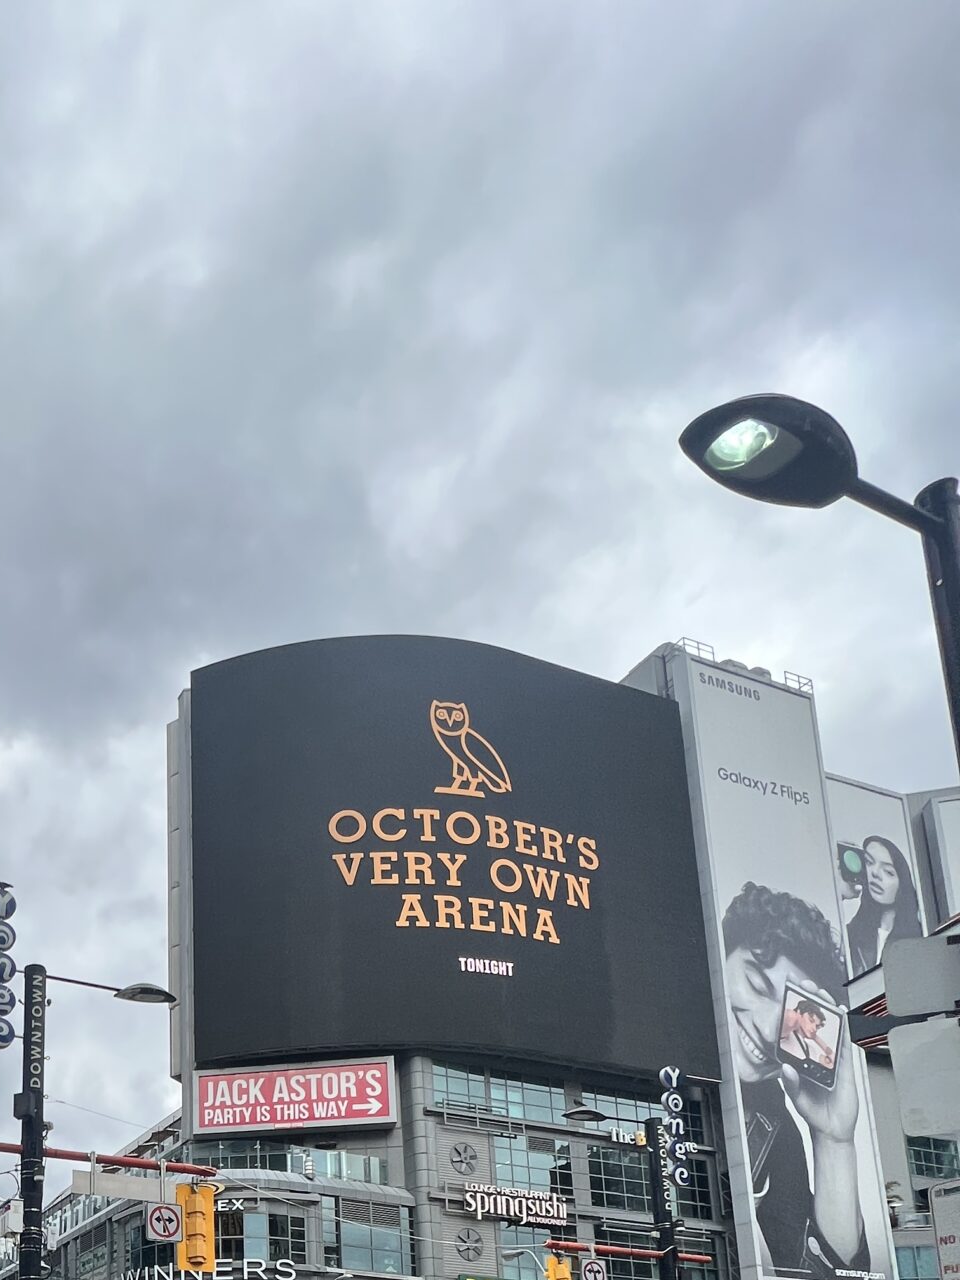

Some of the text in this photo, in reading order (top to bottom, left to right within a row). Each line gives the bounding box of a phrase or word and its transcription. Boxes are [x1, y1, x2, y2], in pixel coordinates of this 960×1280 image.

[698, 671, 761, 701] SAMSUNG
[717, 767, 810, 805] Galaxy Z Flip5
[327, 807, 601, 871] OCTOBER'S
[331, 850, 591, 910] VERY OWN
[395, 893, 561, 945] ARENA
[458, 956, 515, 978] TONIGHT
[29, 974, 44, 1089] DOWNTOWN
[203, 1069, 383, 1108] JACK ASTOR'S
[203, 1100, 349, 1126] PARTY IS THIS WAY
[610, 1127, 636, 1144] The
[656, 1125, 672, 1211] DOWNTOWN
[465, 1182, 551, 1200] LOUNGE RESTAURANT
[940, 1234, 956, 1245] NO
[834, 1268, 886, 1280] samsung.com
